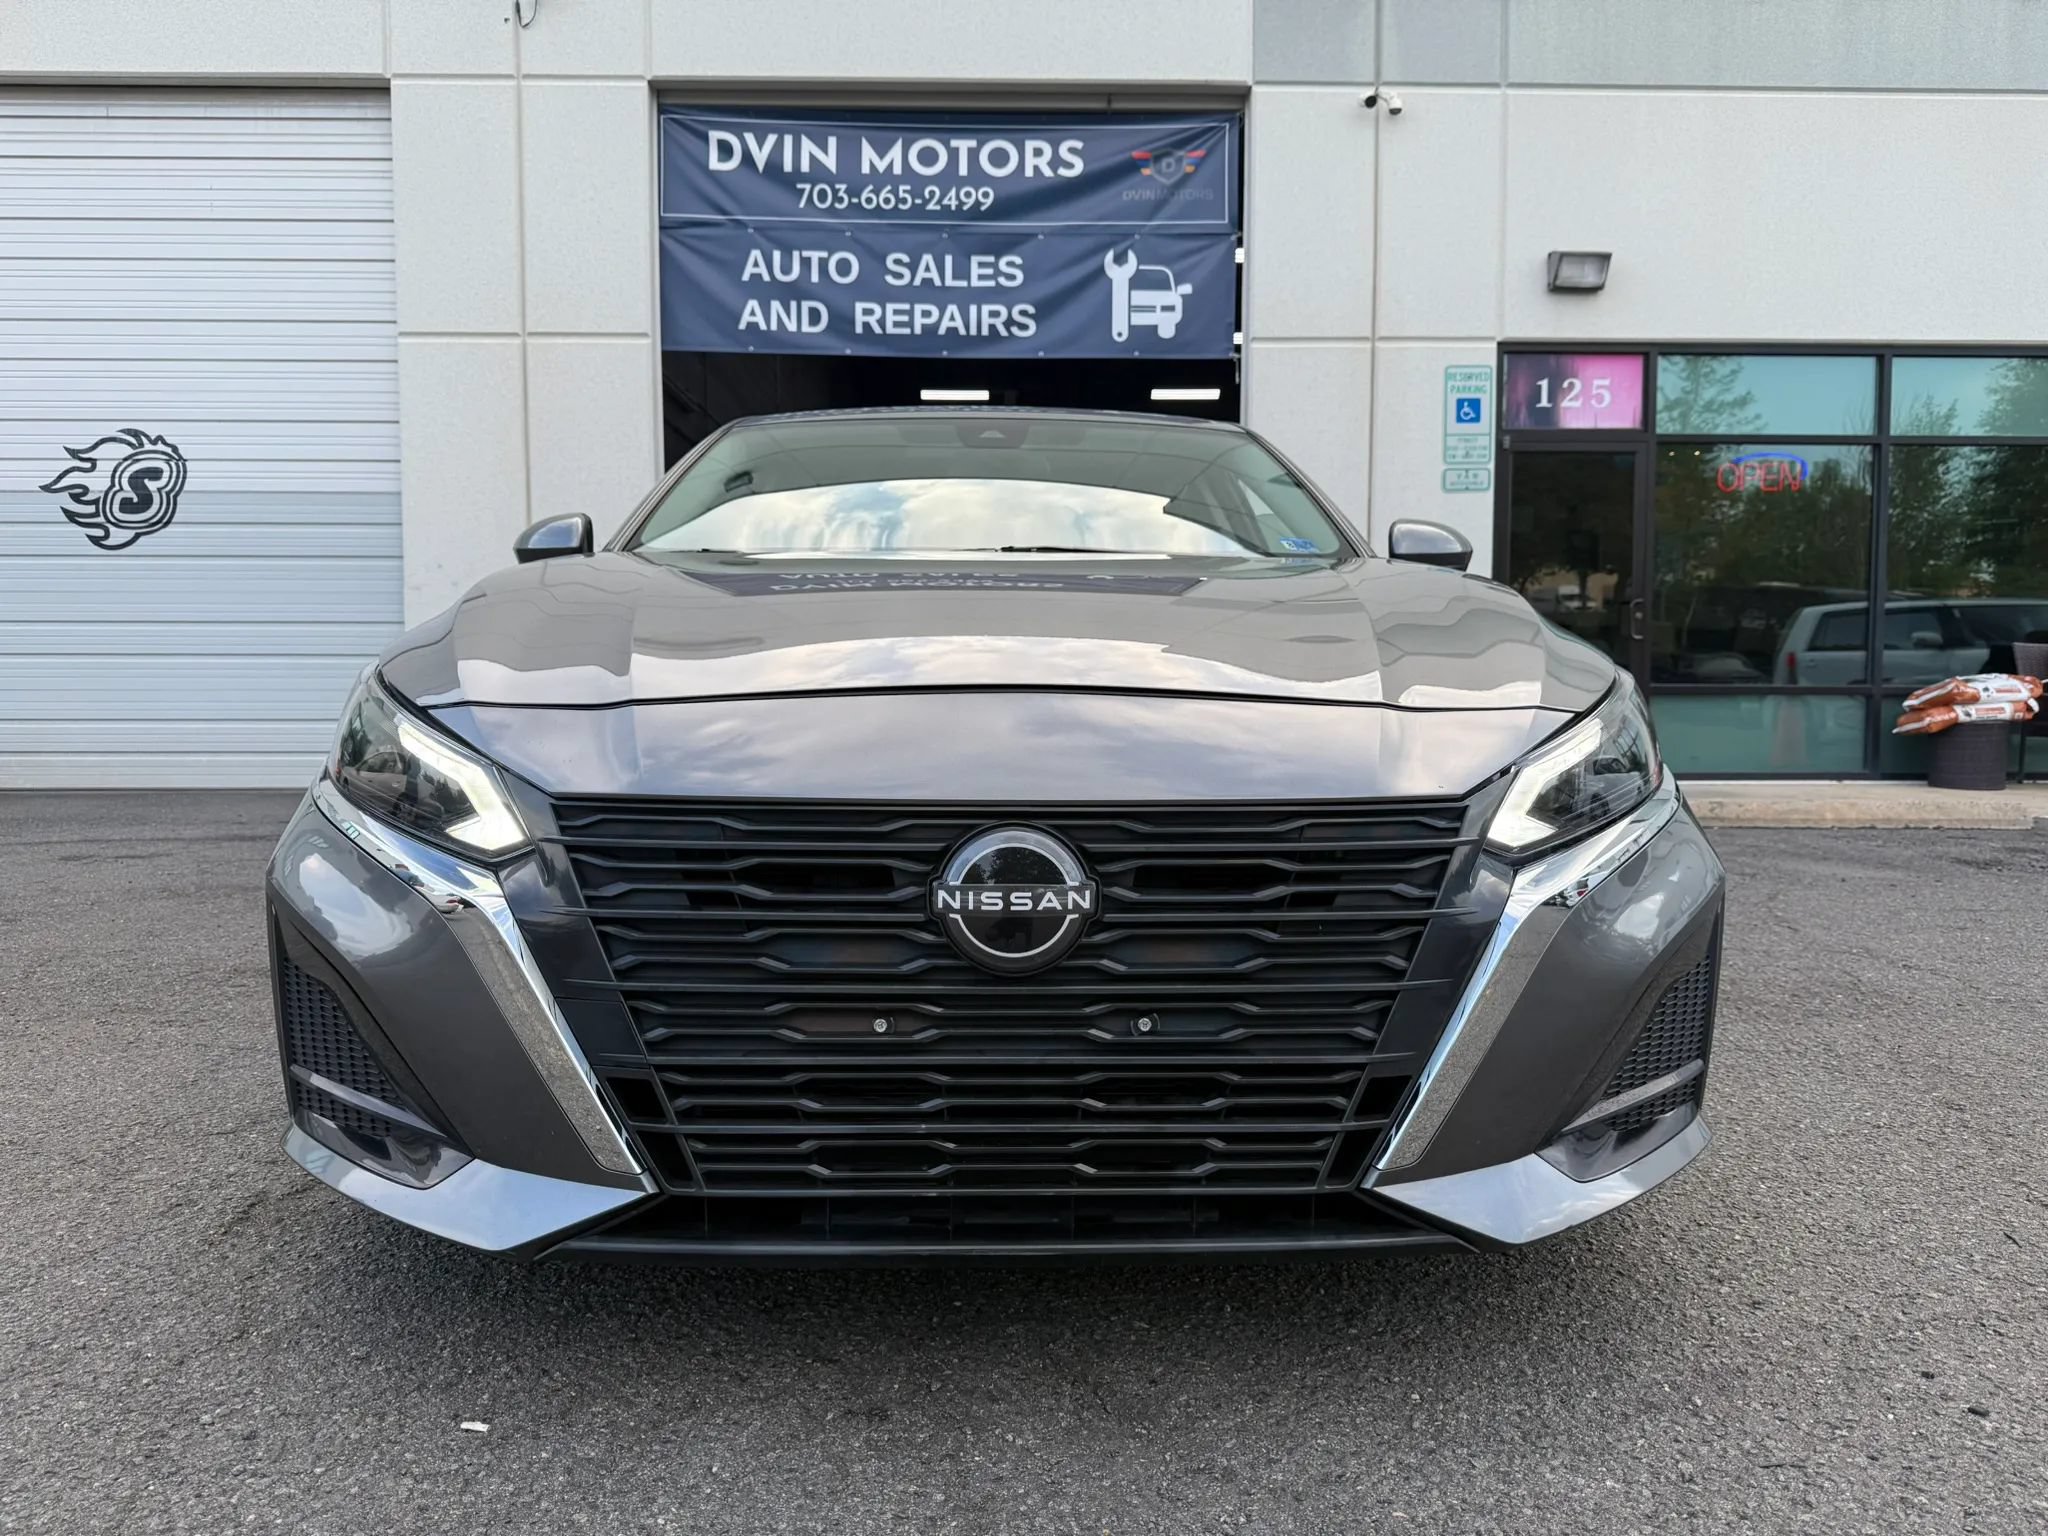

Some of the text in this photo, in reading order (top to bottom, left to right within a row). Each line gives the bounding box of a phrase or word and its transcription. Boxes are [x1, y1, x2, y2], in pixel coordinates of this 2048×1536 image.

[708, 130, 1085, 178] DVIN MOTORS
[796, 183, 995, 211] 703-665-2499
[741, 249, 1025, 287] AUTO SALES
[737, 299, 1037, 338] AND REPAIRS
[1449, 384, 1488, 394] PARKING
[1535, 377, 1612, 409] 125
[1716, 462, 1803, 494] OPEN
[937, 889, 1091, 911] NISSAN
